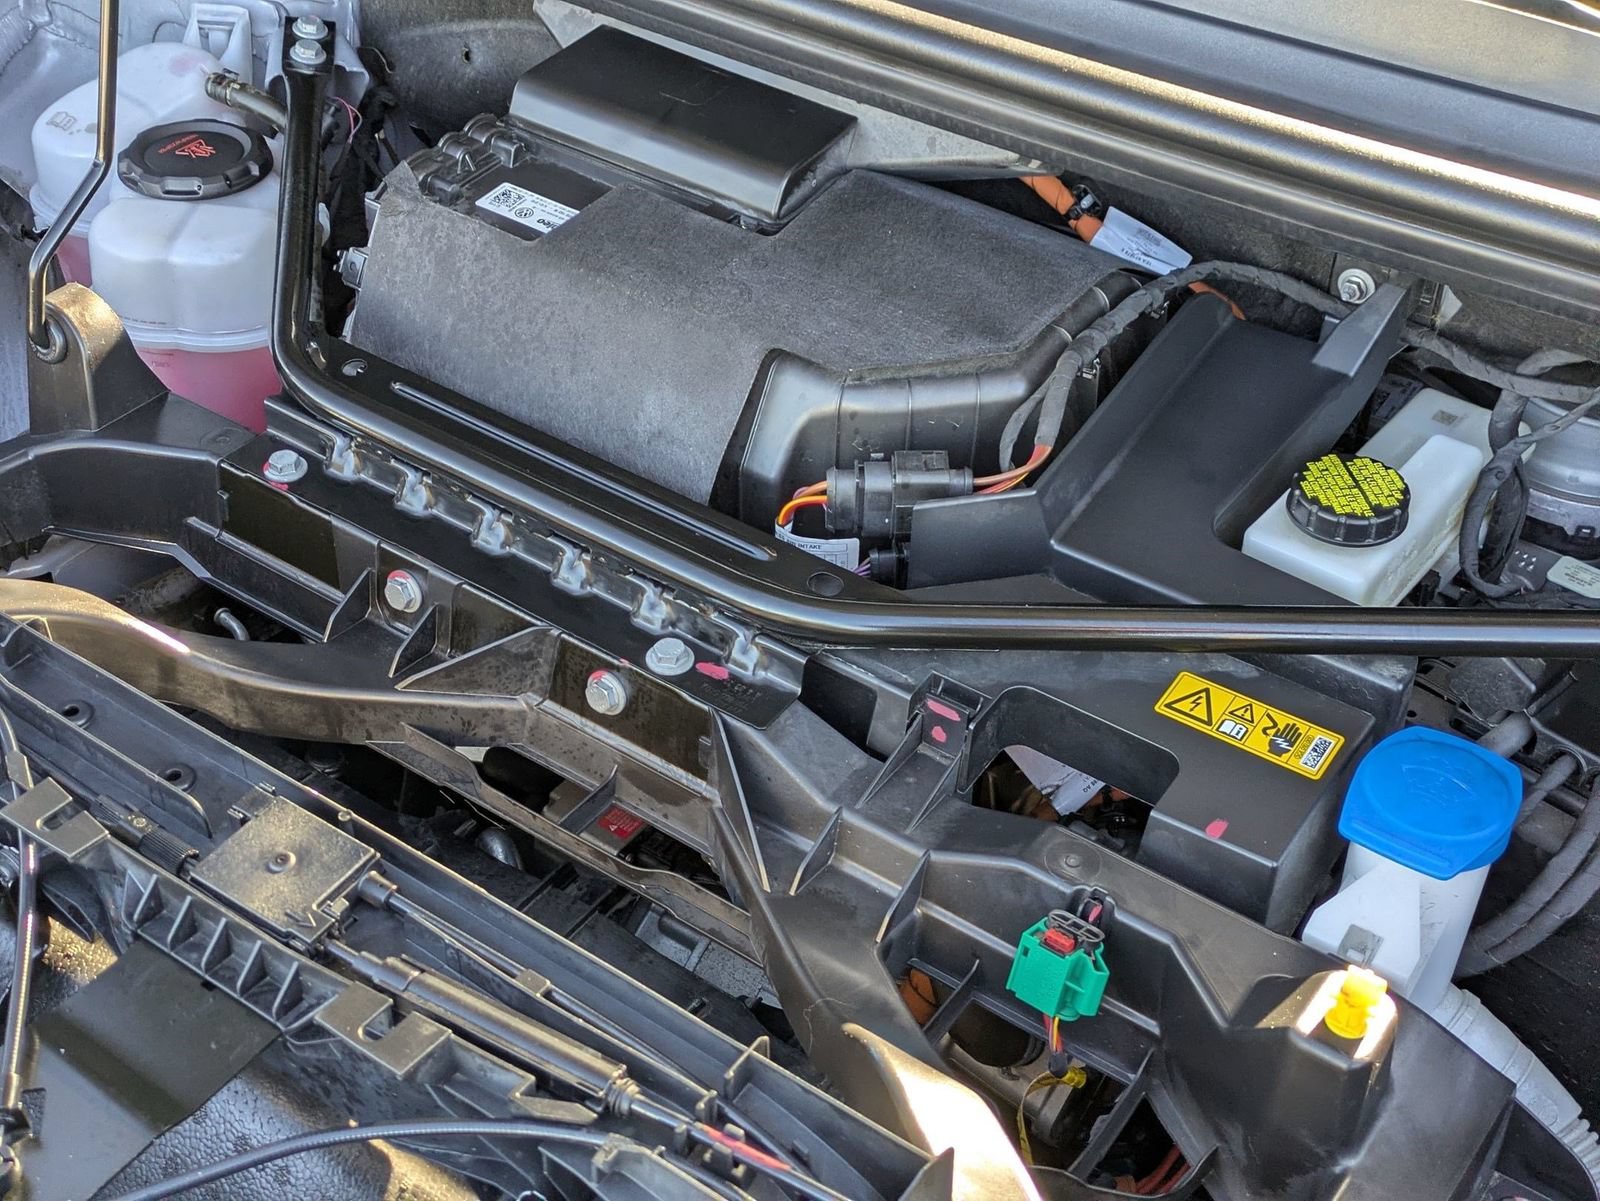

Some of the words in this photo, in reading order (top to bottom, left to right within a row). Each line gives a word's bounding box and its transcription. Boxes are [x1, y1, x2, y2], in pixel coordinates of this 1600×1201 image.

[1332, 474, 1347, 489] AVANT
[1348, 464, 1364, 480] SEALED
[1373, 462, 1388, 476] CLEAN
[1382, 475, 1397, 490] FILLER
[1391, 490, 1404, 500] CAP
[1308, 480, 1331, 506] CONTENANT
[1367, 481, 1382, 494] FLUID
[1375, 493, 1390, 508] FROM
